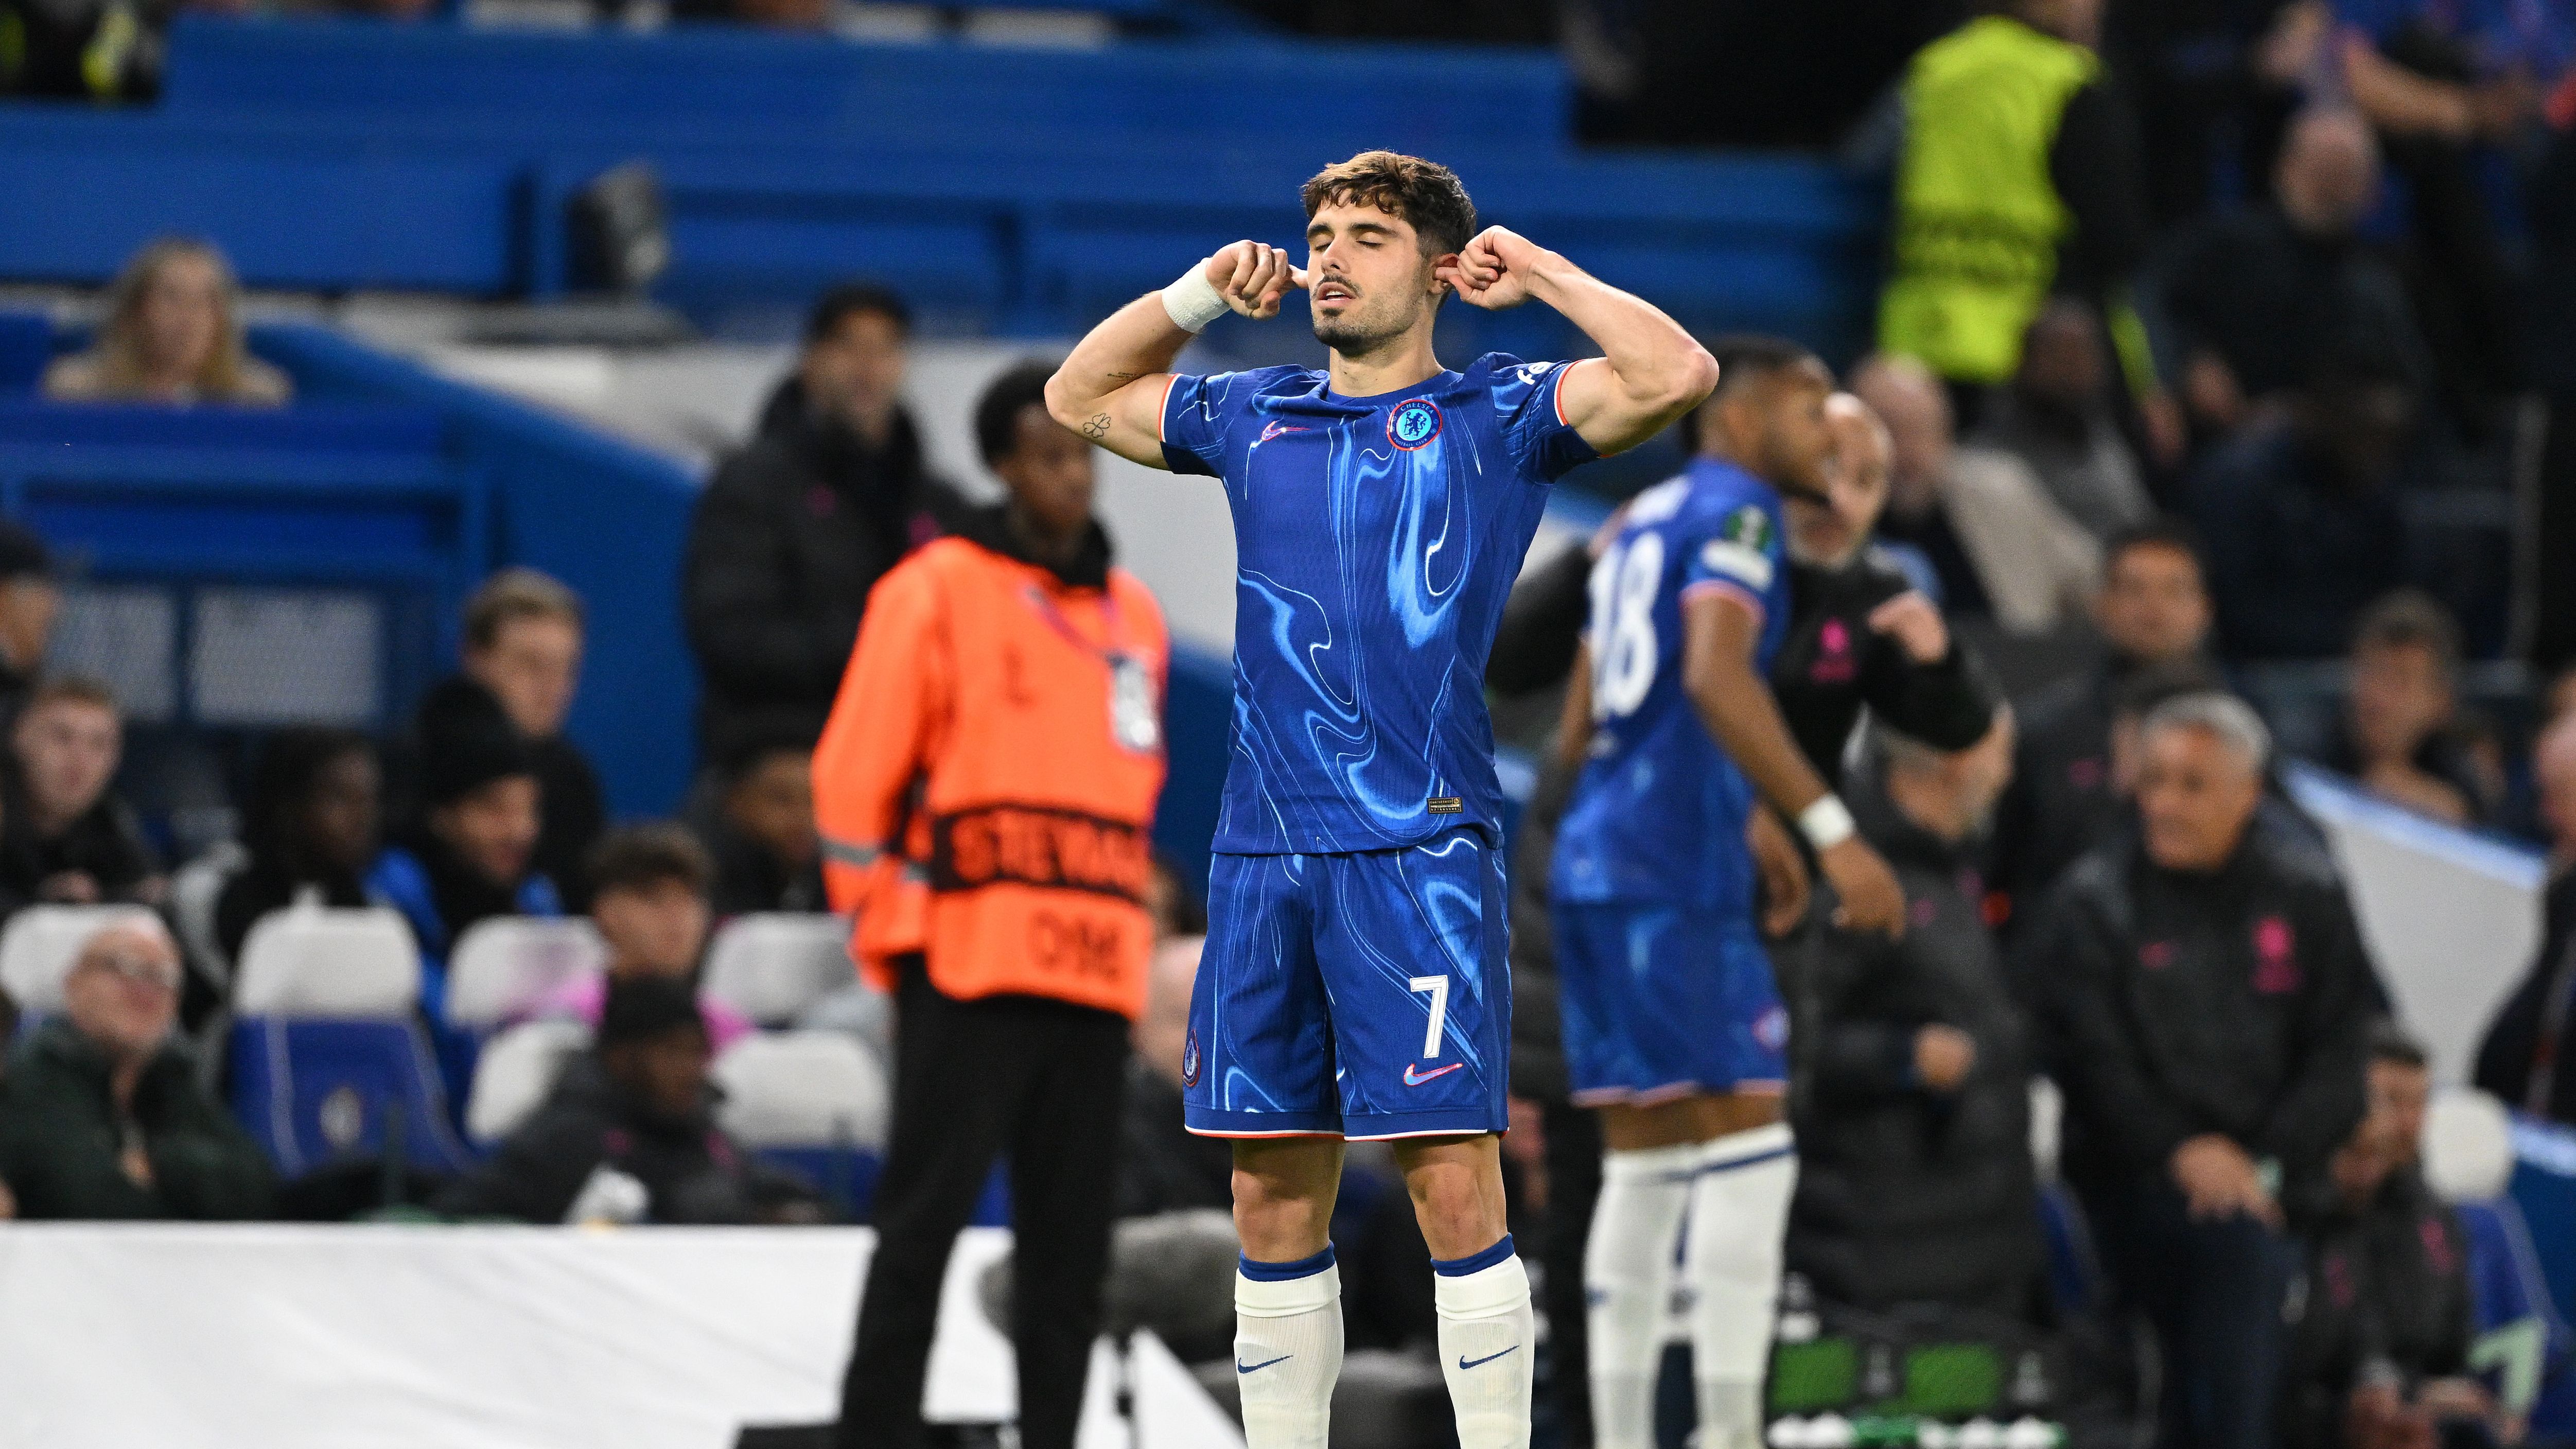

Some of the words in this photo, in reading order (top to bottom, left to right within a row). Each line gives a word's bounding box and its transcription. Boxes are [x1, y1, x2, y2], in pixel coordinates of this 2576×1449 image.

[1400, 403, 1434, 414] CHELSEA
[1394, 438, 1413, 447] FOOTBALL
[1409, 974, 1449, 1059] 7
